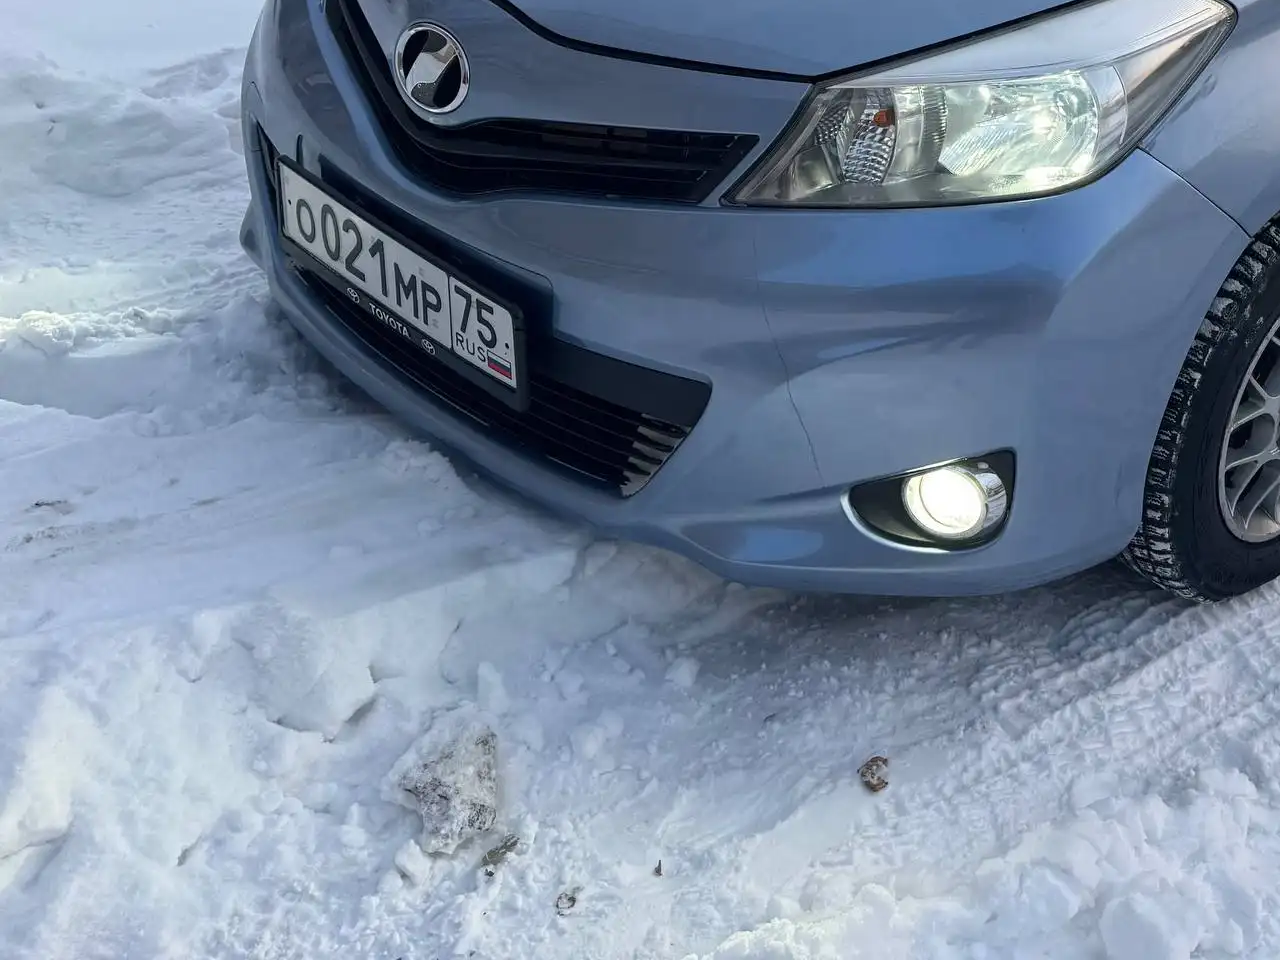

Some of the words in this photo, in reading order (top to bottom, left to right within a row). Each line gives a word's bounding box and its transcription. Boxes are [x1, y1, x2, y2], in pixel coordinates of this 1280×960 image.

[369, 302, 410, 338] TOYOTA
[454, 284, 497, 349] 75
[455, 333, 486, 363] RUS
